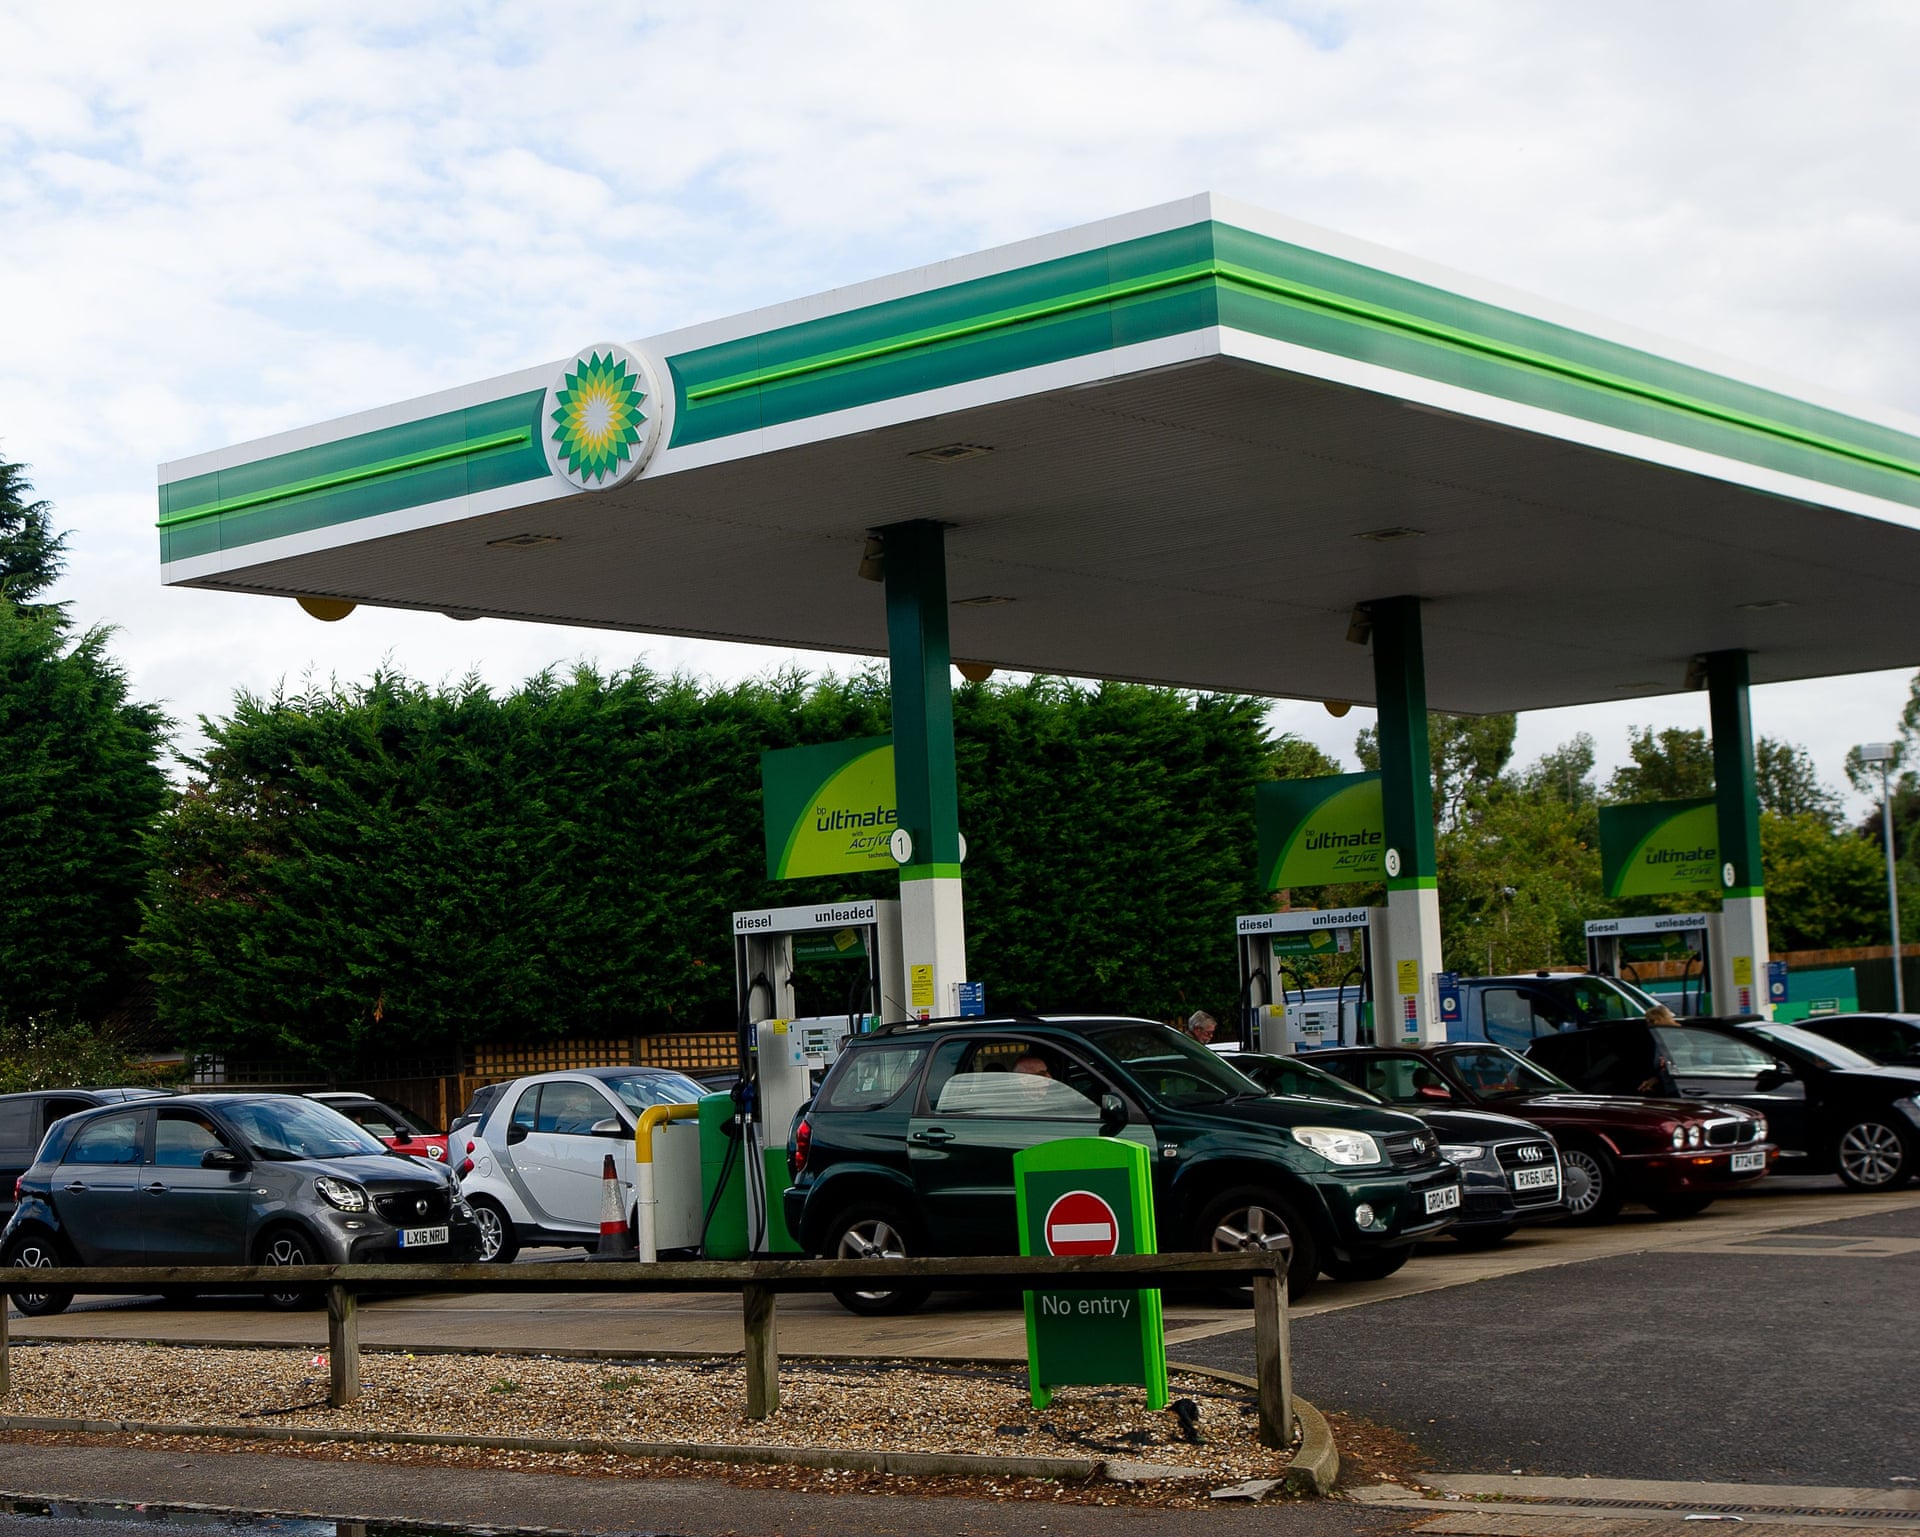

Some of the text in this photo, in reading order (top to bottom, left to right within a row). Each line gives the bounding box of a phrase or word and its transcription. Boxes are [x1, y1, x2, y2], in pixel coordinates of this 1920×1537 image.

[817, 806, 827, 817] bp
[817, 805, 897, 832] ultimate
[897, 836, 904, 855] 1
[1306, 828, 1382, 850] ultimate
[1336, 853, 1377, 865] ACTIVE
[1389, 855, 1396, 870] 3
[1646, 847, 1716, 864] ultimate
[736, 905, 874, 930] diesel unleaded
[1239, 911, 1367, 931] diesel unleaded
[1587, 916, 1705, 933] diesel unleaded
[1519, 1169, 1555, 1185] RX66 UHE
[406, 1230, 446, 1245] LX16 NRU
[1042, 1295, 1131, 1319] No entry
